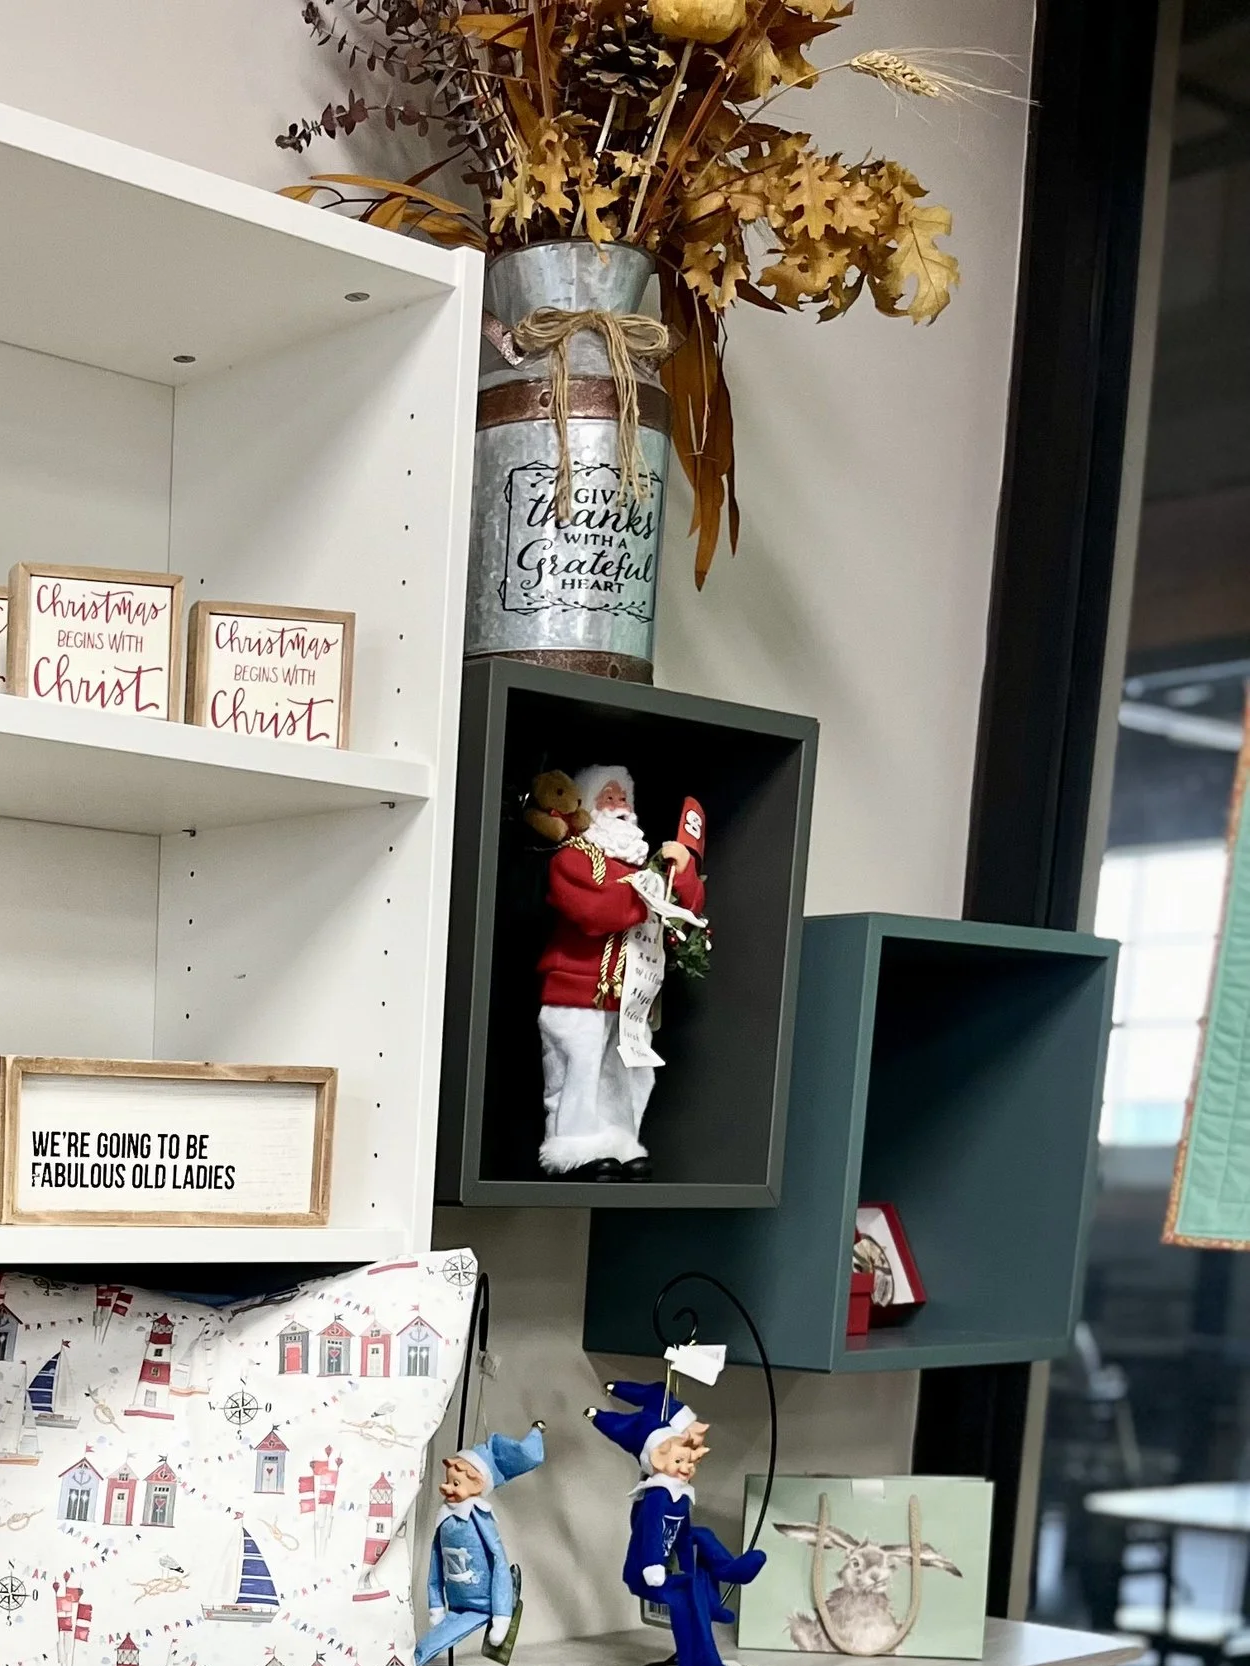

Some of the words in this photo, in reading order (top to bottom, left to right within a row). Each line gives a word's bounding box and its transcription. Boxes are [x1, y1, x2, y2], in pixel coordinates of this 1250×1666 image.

[563, 532, 613, 548] WITH
[617, 538, 628, 549] A
[516, 538, 653, 590] Grateful
[560, 577, 625, 594] HEART
[36, 583, 167, 627] Christmas
[57, 629, 105, 651] BEGINS
[107, 630, 144, 654] WITH
[215, 620, 339, 661] Christmas
[33, 654, 163, 713] Christ
[233, 663, 279, 684] BEGINS
[281, 664, 317, 687] WITH
[210, 687, 334, 742] Christ
[32, 1130, 90, 1159] WE'RE
[96, 1132, 151, 1160] GOING
[158, 1133, 180, 1160] TO
[185, 1133, 209, 1160] BE
[31, 1161, 126, 1189] FABULOUS
[131, 1164, 166, 1190] OLD
[172, 1164, 236, 1190] LADIES
